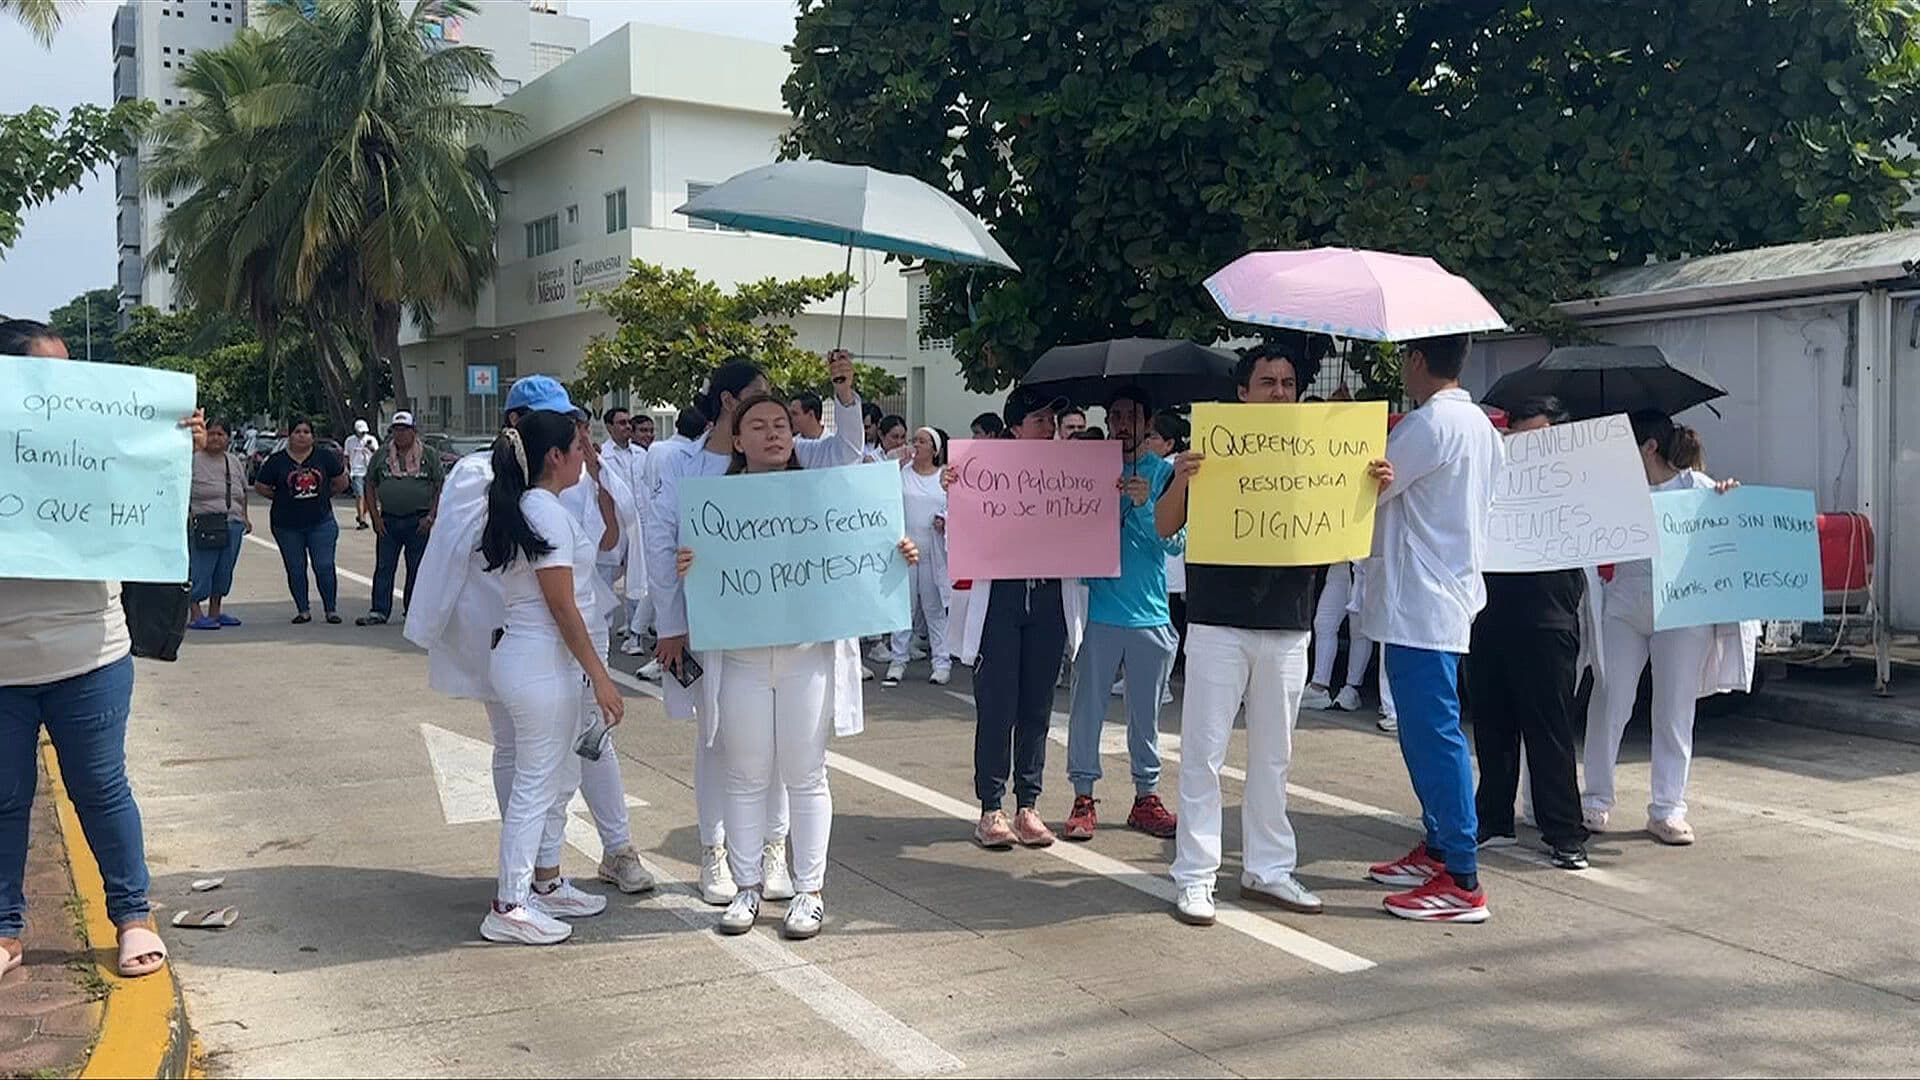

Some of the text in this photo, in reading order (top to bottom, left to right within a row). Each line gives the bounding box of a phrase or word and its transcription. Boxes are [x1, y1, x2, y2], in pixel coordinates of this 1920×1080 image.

[537, 280, 566, 304] México
[23, 391, 156, 422] operando
[15, 429, 117, 472] Familiar
[1328, 440, 1370, 458] UNA
[1238, 473, 1347, 495] RESIDENCIA
[37, 498, 91, 524] QUE
[982, 500, 1006, 519] no
[1737, 514, 1765, 529] SIN
[1234, 508, 1346, 541] DIGNA!
[1514, 524, 1650, 561] SEGUROS
[719, 568, 762, 598] NO
[1713, 577, 1732, 592] en
